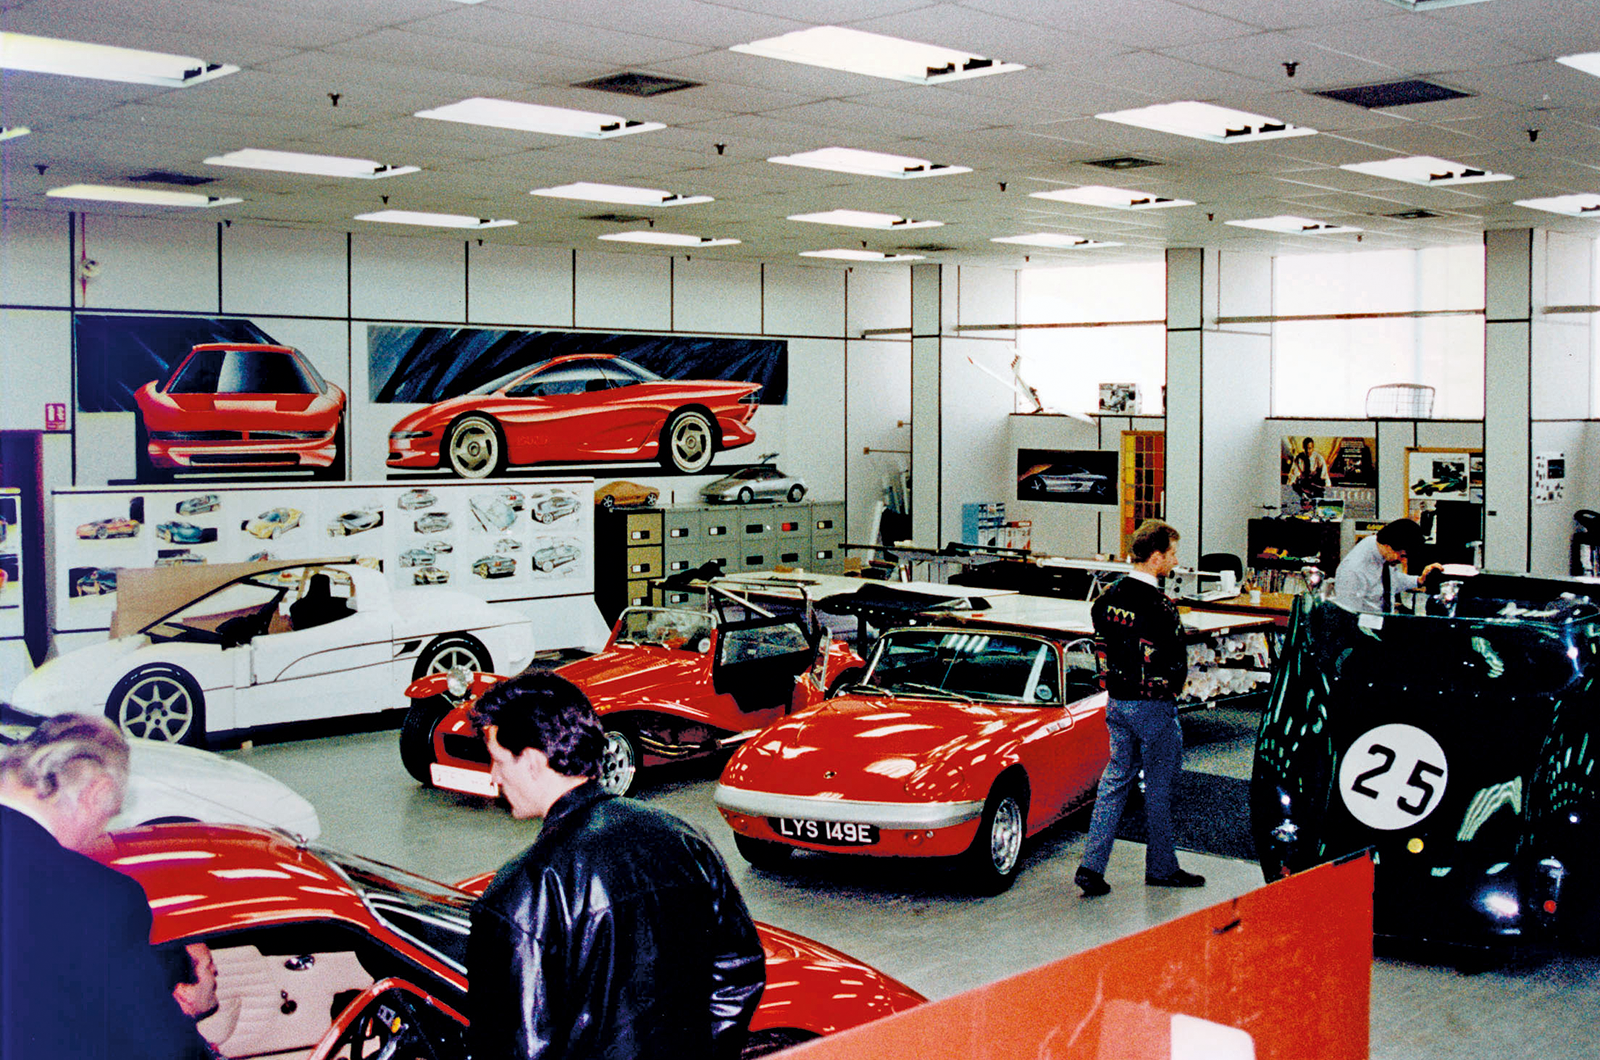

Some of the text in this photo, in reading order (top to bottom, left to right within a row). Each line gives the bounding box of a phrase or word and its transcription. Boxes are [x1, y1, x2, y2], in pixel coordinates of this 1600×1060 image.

[1351, 743, 1445, 816] 25
[780, 818, 872, 843] LYS 149E
